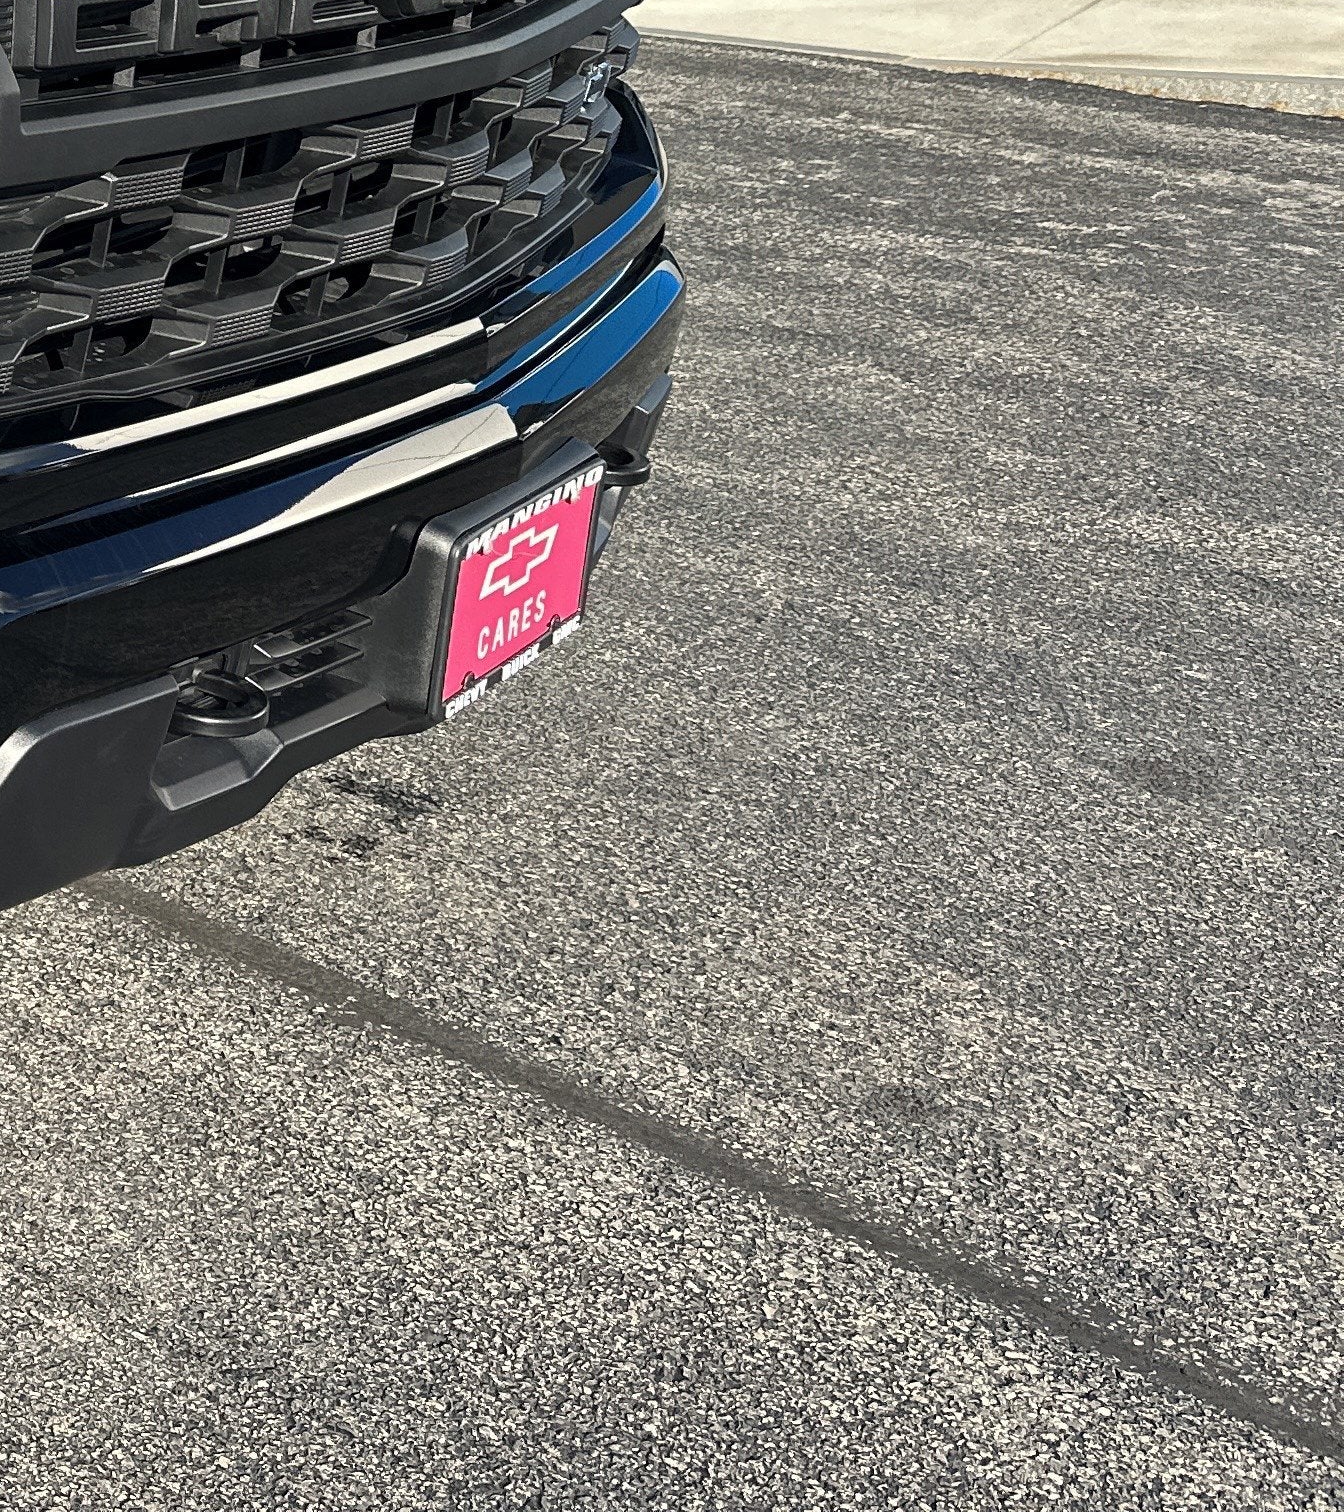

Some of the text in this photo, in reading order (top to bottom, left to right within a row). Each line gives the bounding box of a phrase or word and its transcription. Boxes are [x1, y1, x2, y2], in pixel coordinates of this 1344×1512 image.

[465, 465, 604, 561] MANGINO
[477, 589, 547, 660] CARES
[445, 678, 488, 719] CHEVY
[501, 643, 540, 681] BUICK
